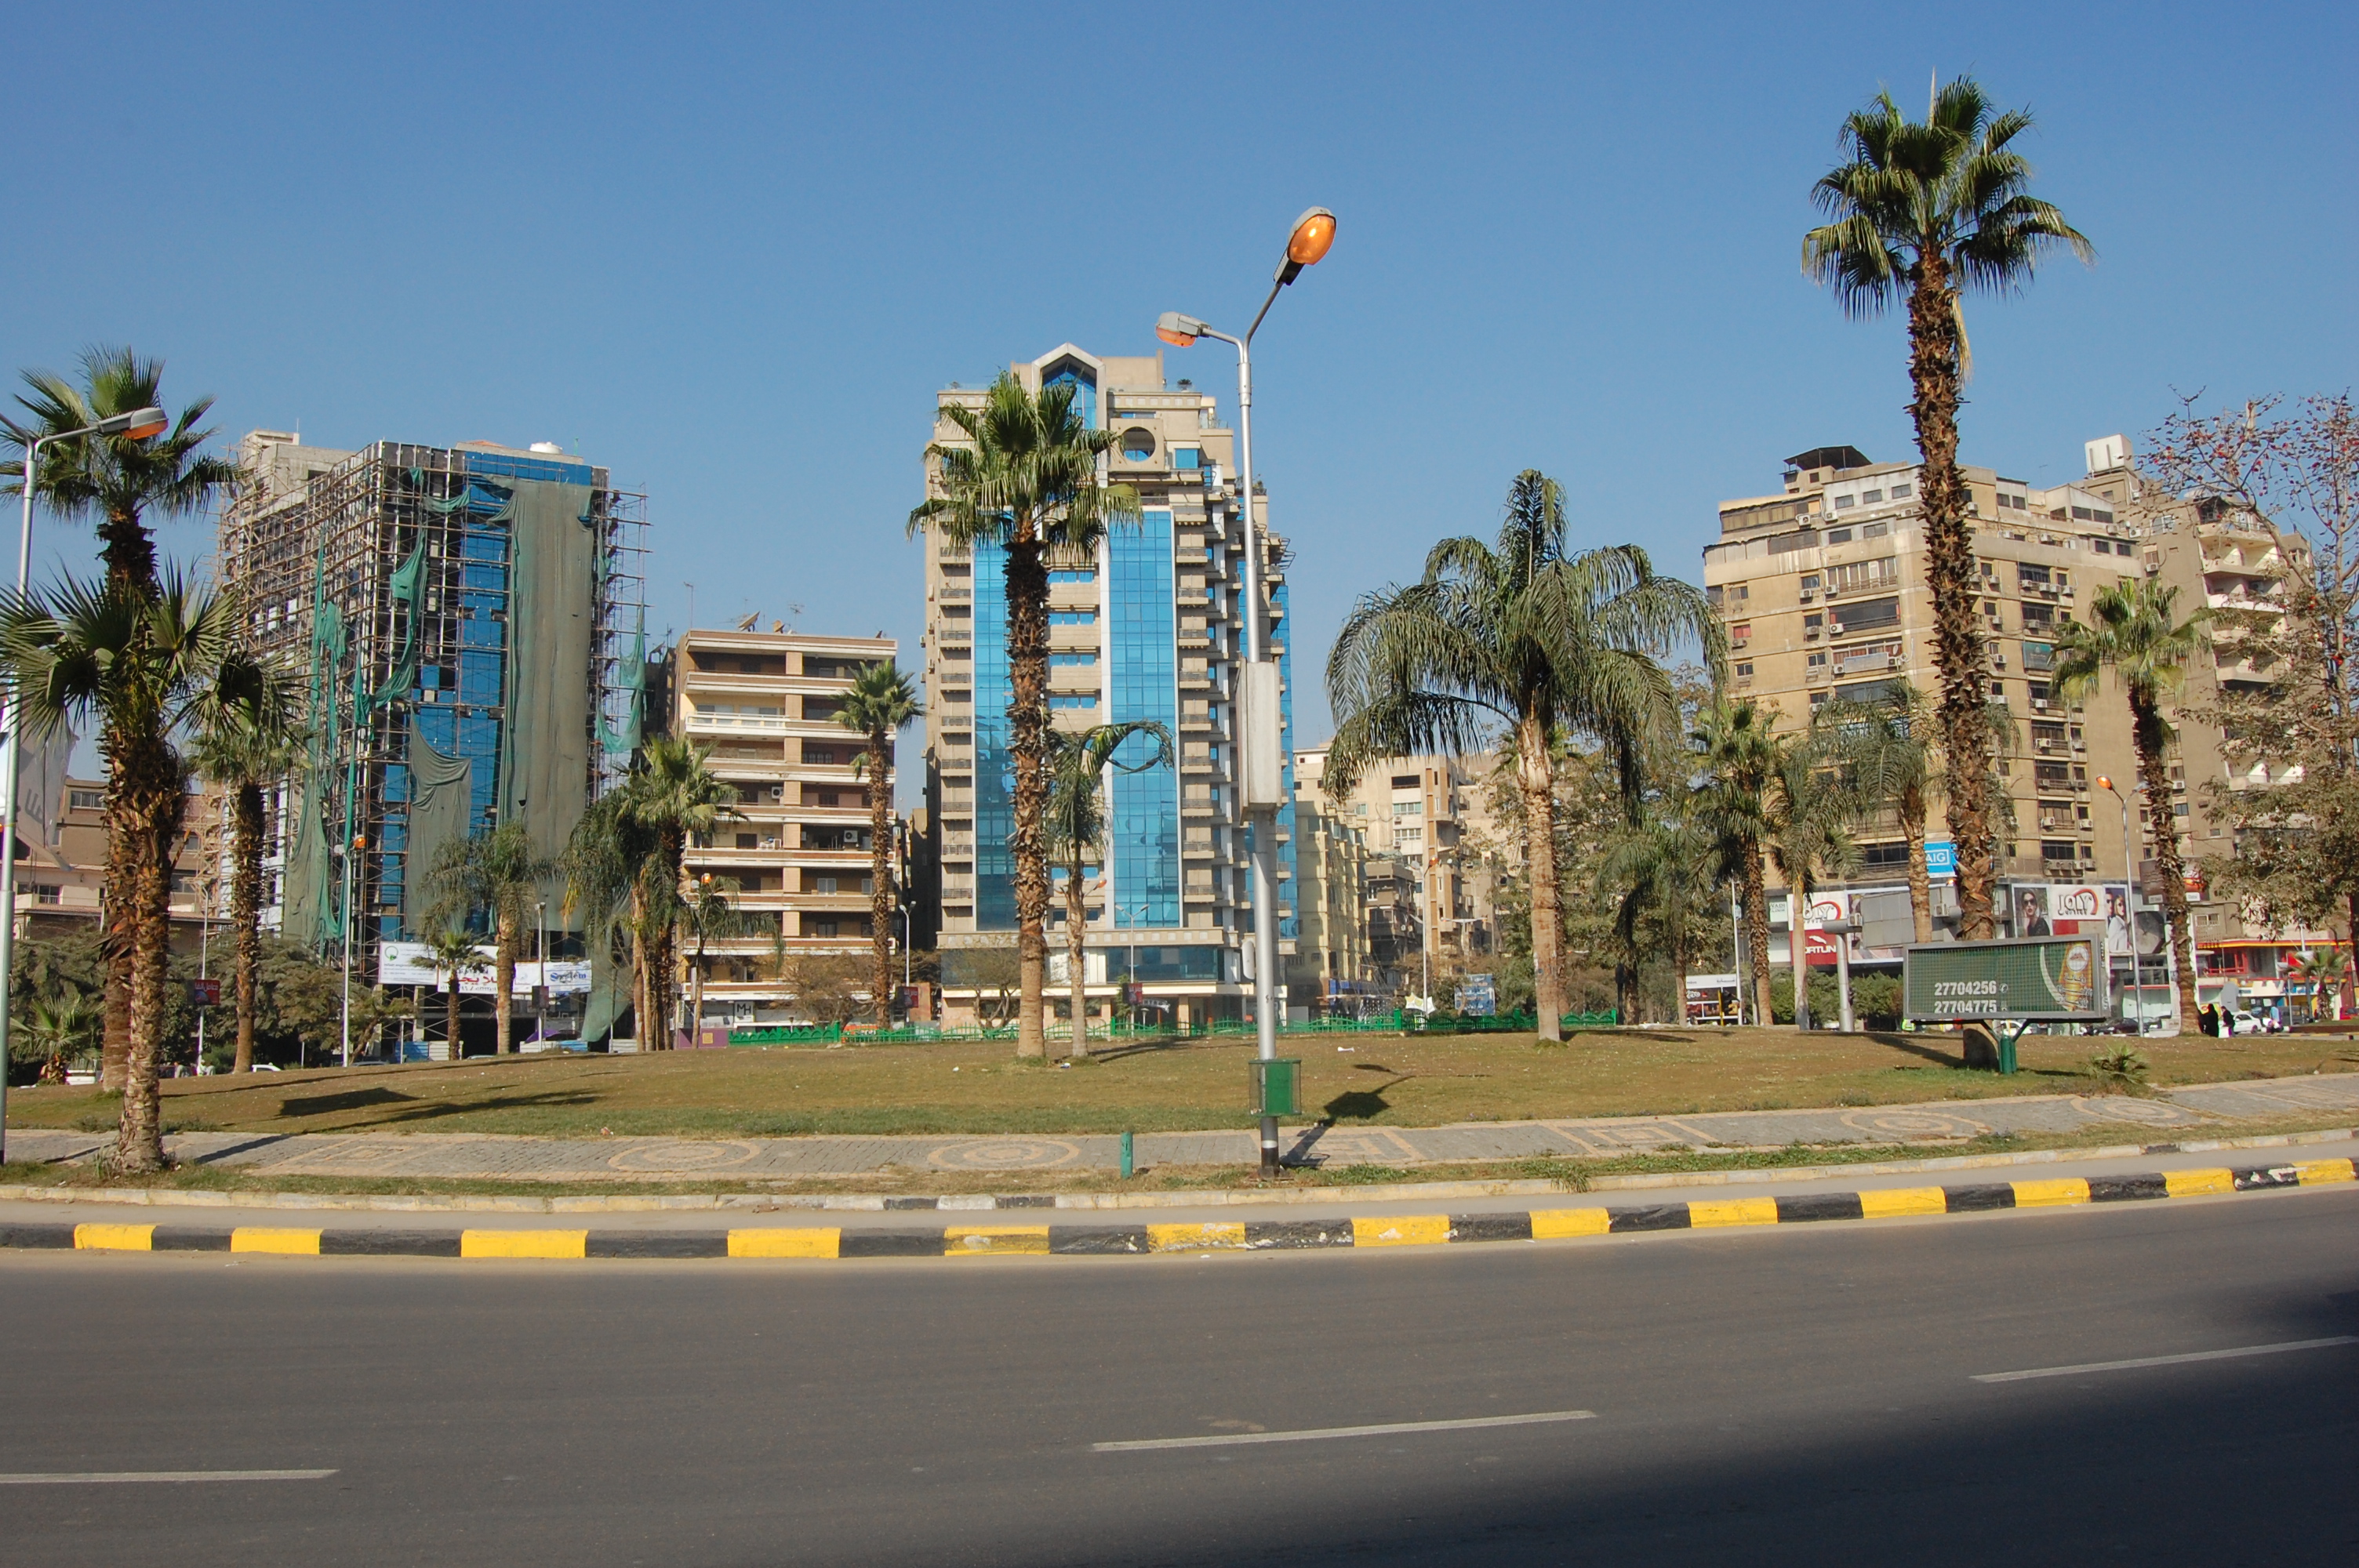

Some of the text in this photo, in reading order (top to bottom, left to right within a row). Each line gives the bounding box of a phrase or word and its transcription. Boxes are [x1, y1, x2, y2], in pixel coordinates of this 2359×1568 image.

[1925, 852, 1946, 863] AIG
[2058, 894, 2088, 915] JOLY
[1934, 981, 1997, 996] 27704256
[1934, 1000, 1997, 1014] 27704775
